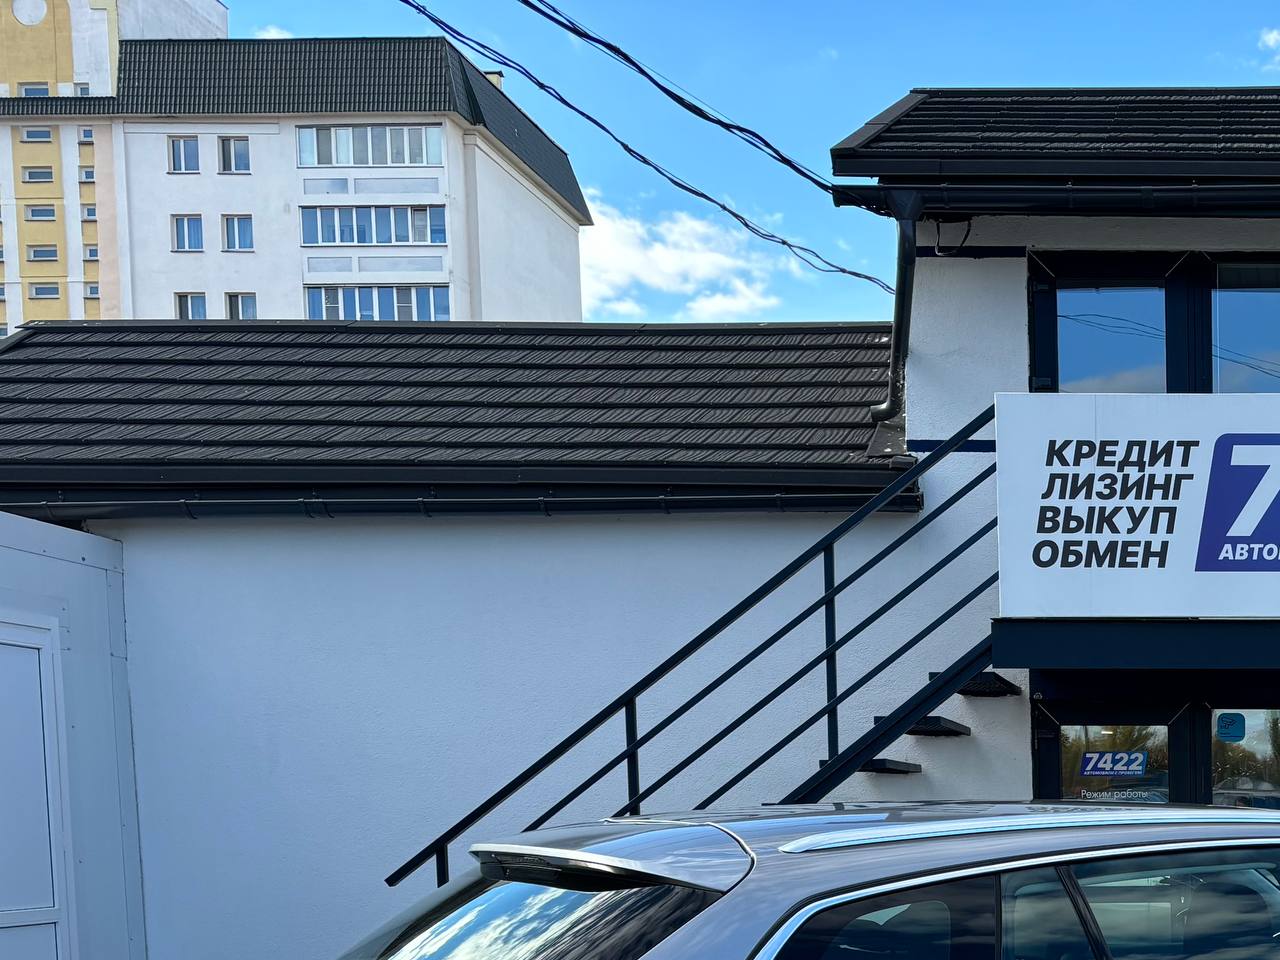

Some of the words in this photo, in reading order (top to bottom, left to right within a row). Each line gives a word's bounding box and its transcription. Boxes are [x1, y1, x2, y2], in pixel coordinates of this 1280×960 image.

[1045, 439, 1200, 473] КРЕДИТ
[1040, 472, 1195, 501] ЛИЗИНГ
[1036, 505, 1178, 535] ВЫКУП
[1031, 539, 1170, 569] ОБМЕН
[1084, 752, 1144, 771] 7422
[1081, 789, 1111, 799] Режим
